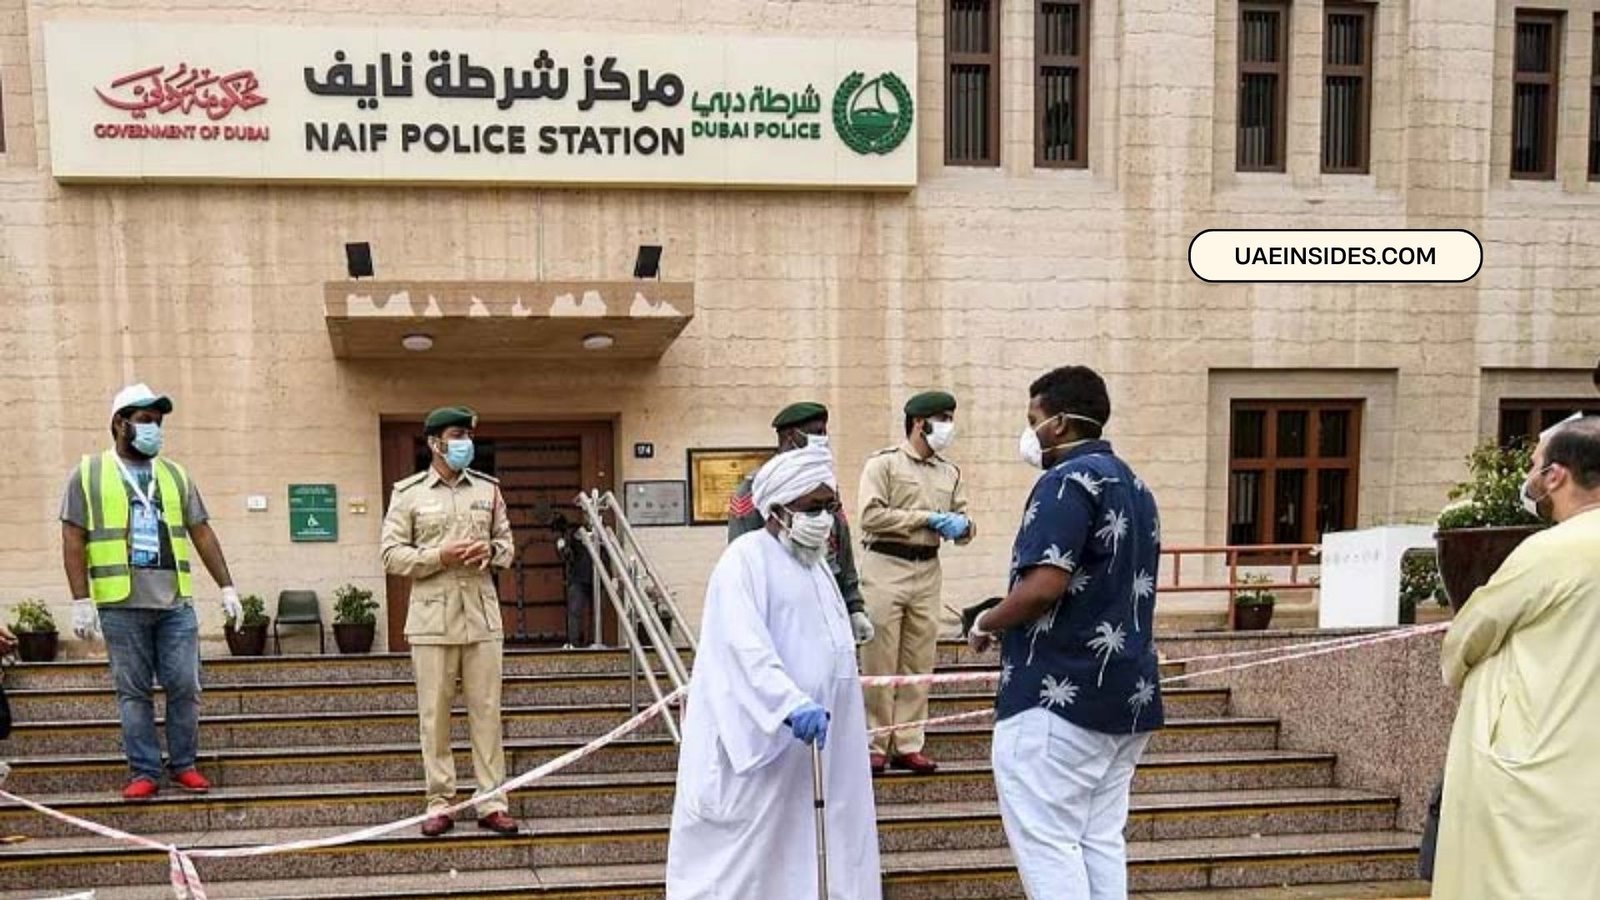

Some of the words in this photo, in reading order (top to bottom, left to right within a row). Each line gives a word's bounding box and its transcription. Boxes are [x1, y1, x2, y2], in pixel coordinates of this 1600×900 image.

[303, 50, 414, 110] نايف
[425, 49, 569, 111] شرطة
[577, 54, 685, 113] مركز
[691, 90, 747, 119] دبي
[749, 83, 822, 120] شرطة
[93, 123, 196, 141] GOVERNMENT
[199, 125, 220, 141] OF
[223, 125, 270, 142] DUBAI
[304, 121, 388, 153] NAIF
[401, 123, 527, 155] POLICE
[537, 125, 685, 157] STATION
[691, 121, 749, 139] DUBAI
[753, 122, 822, 140] POLICE
